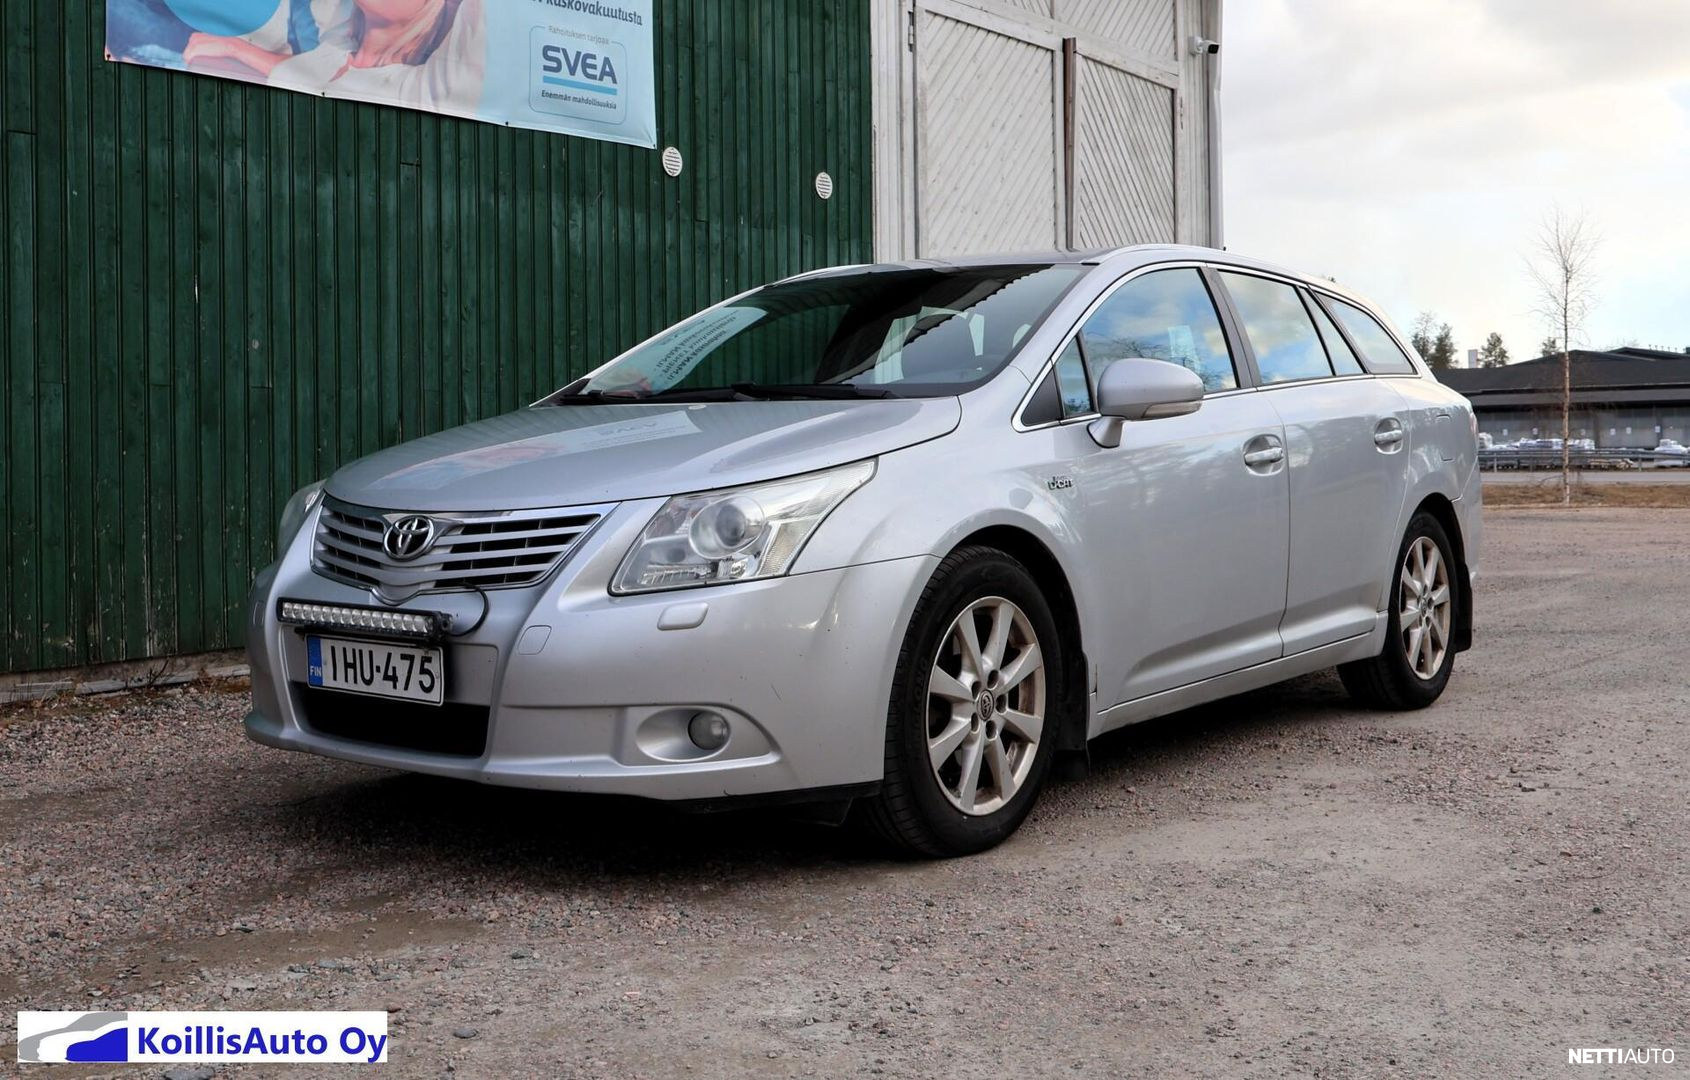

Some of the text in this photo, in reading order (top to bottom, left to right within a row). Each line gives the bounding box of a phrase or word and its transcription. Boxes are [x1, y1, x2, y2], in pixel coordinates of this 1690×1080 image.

[542, 44, 618, 85] SVEA
[309, 665, 322, 677] FIN
[330, 645, 435, 694] IHU-475
